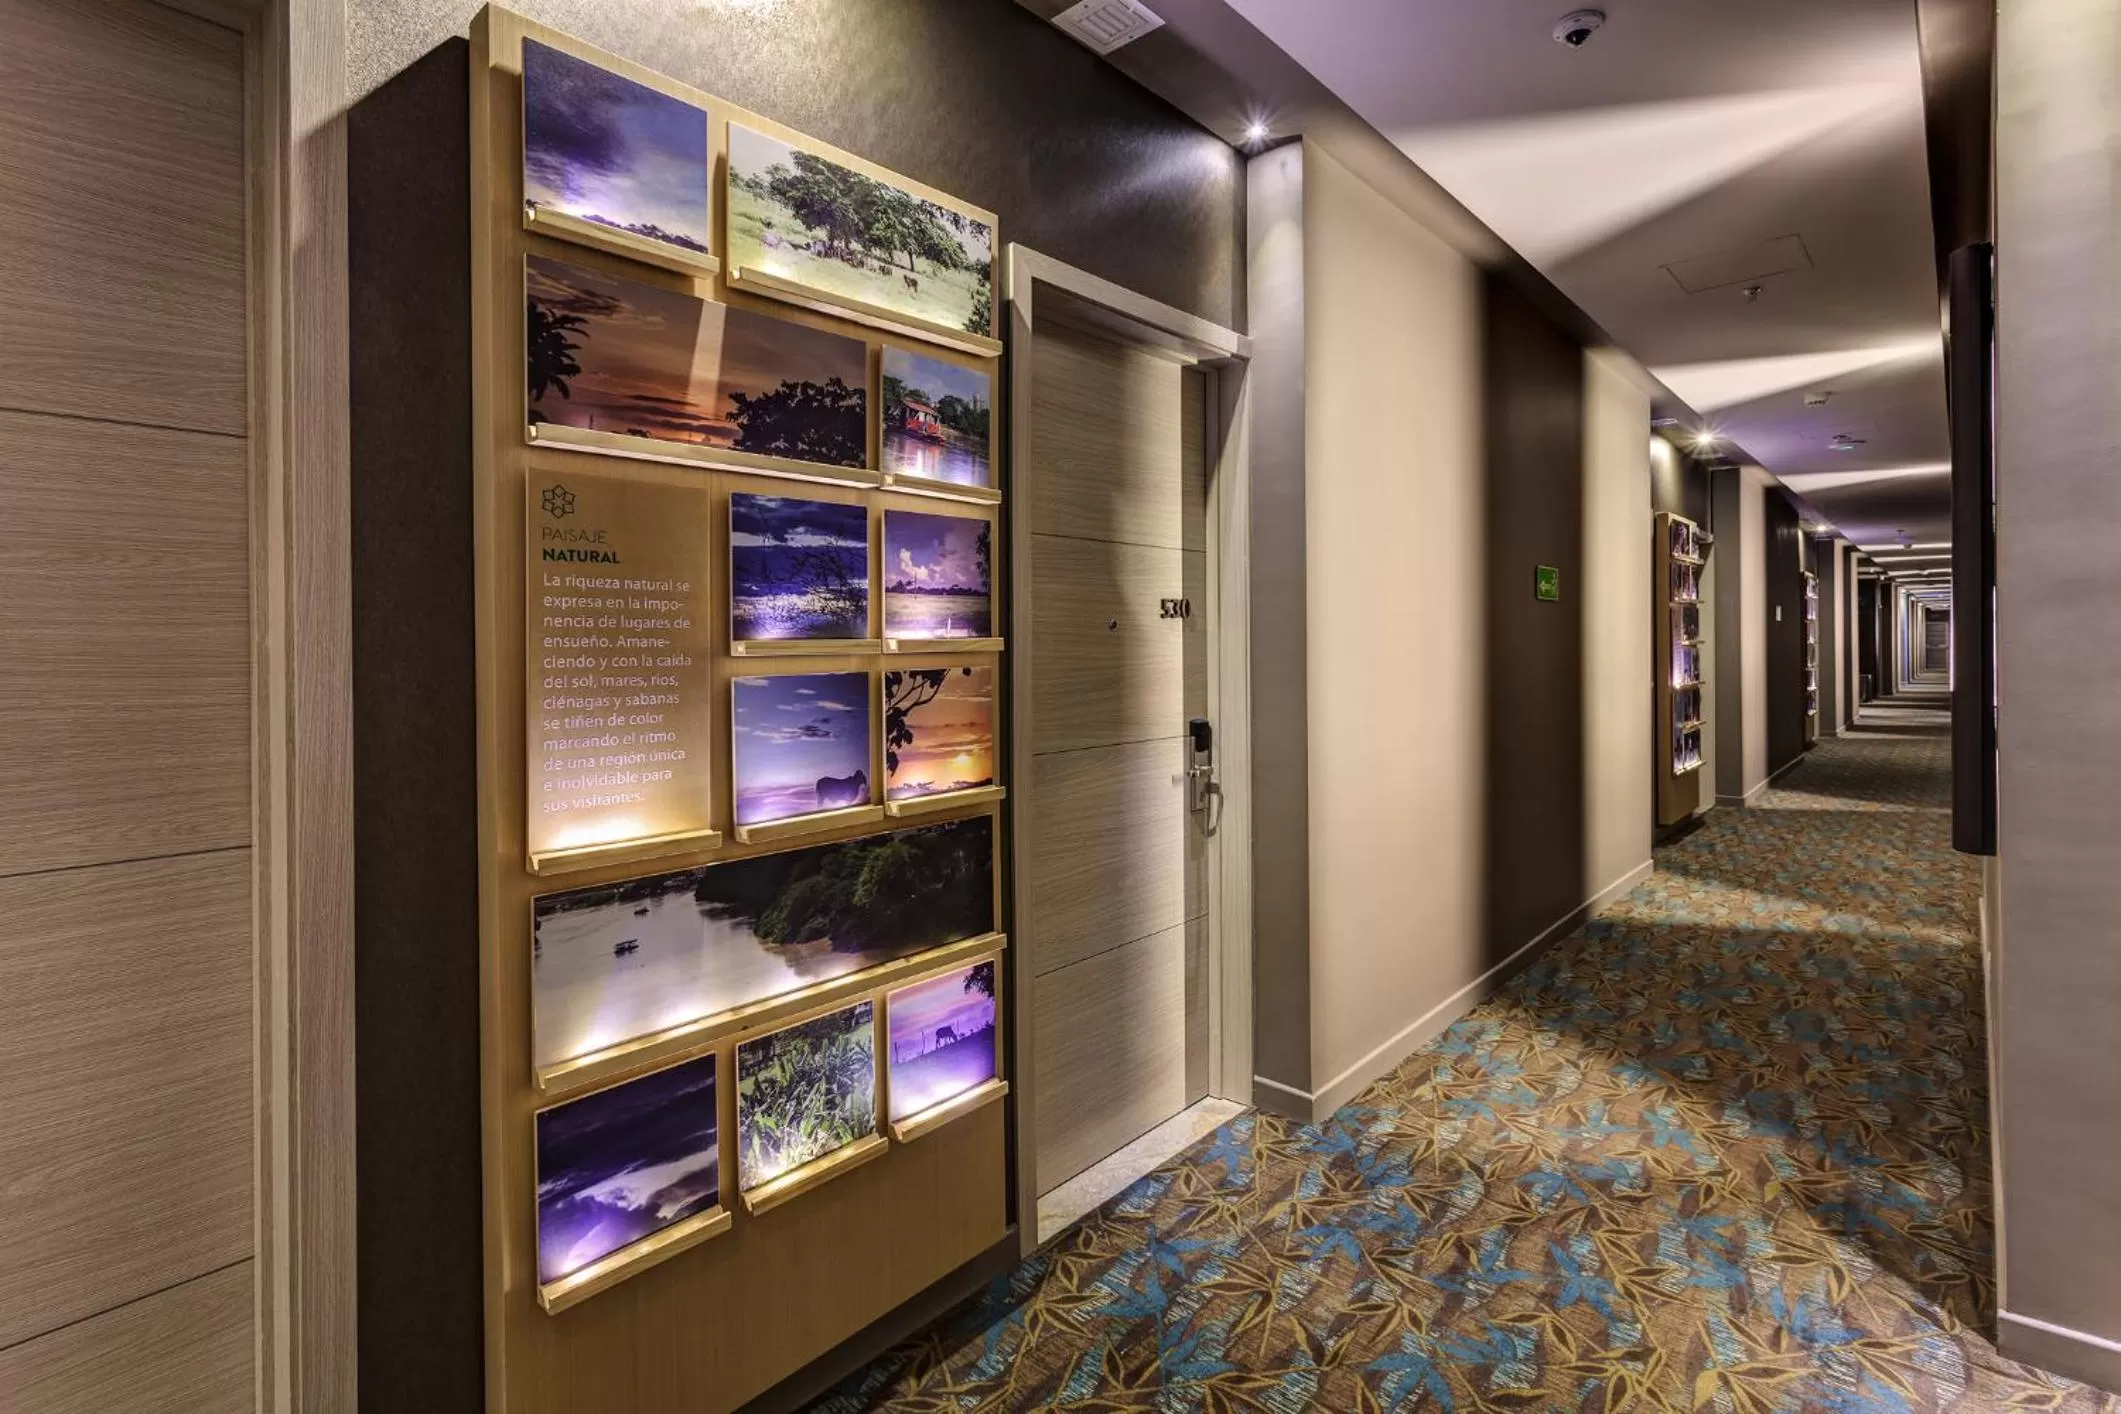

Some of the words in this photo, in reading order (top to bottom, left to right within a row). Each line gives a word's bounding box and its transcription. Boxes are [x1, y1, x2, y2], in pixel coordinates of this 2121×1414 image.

[542, 526, 607, 544] PAISAJE
[542, 548, 620, 564] NATURAL
[544, 572, 561, 586] La
[565, 575, 620, 590] riqueza
[624, 578, 673, 591] natural
[676, 582, 690, 592] se
[544, 595, 602, 610] expresa
[606, 598, 624, 608] en
[628, 596, 640, 609] la
[644, 598, 684, 612] impo-
[1160, 598, 1190, 618] 530
[543, 615, 594, 628] nencia
[598, 616, 617, 628] de
[621, 617, 671, 631] lugares
[674, 617, 691, 629] de
[544, 635, 613, 648] ensueño.
[617, 636, 671, 648] Amane-
[544, 654, 596, 668] ciendo
[600, 657, 608, 671] y
[611, 656, 638, 667] con
[642, 655, 653, 666] la
[544, 675, 567, 688] del
[573, 675, 597, 688] sol,
[601, 676, 648, 687] mares,
[544, 695, 610, 710] ciénagas
[613, 697, 621, 710] y
[625, 693, 680, 706] sabanas
[543, 719, 560, 730] se
[564, 715, 604, 729] tiñen
[607, 713, 625, 726] de
[629, 713, 664, 725] color
[543, 733, 619, 751] marcando
[623, 732, 635, 744] el
[639, 731, 677, 744] ritmo
[544, 757, 564, 771] de
[567, 757, 595, 769] una
[600, 752, 646, 768] región
[650, 749, 686, 761] única
[544, 781, 553, 792] e
[558, 769, 640, 790] inolvidable
[642, 769, 673, 784] para
[544, 799, 568, 813] sus
[572, 792, 645, 808] visitantes.
